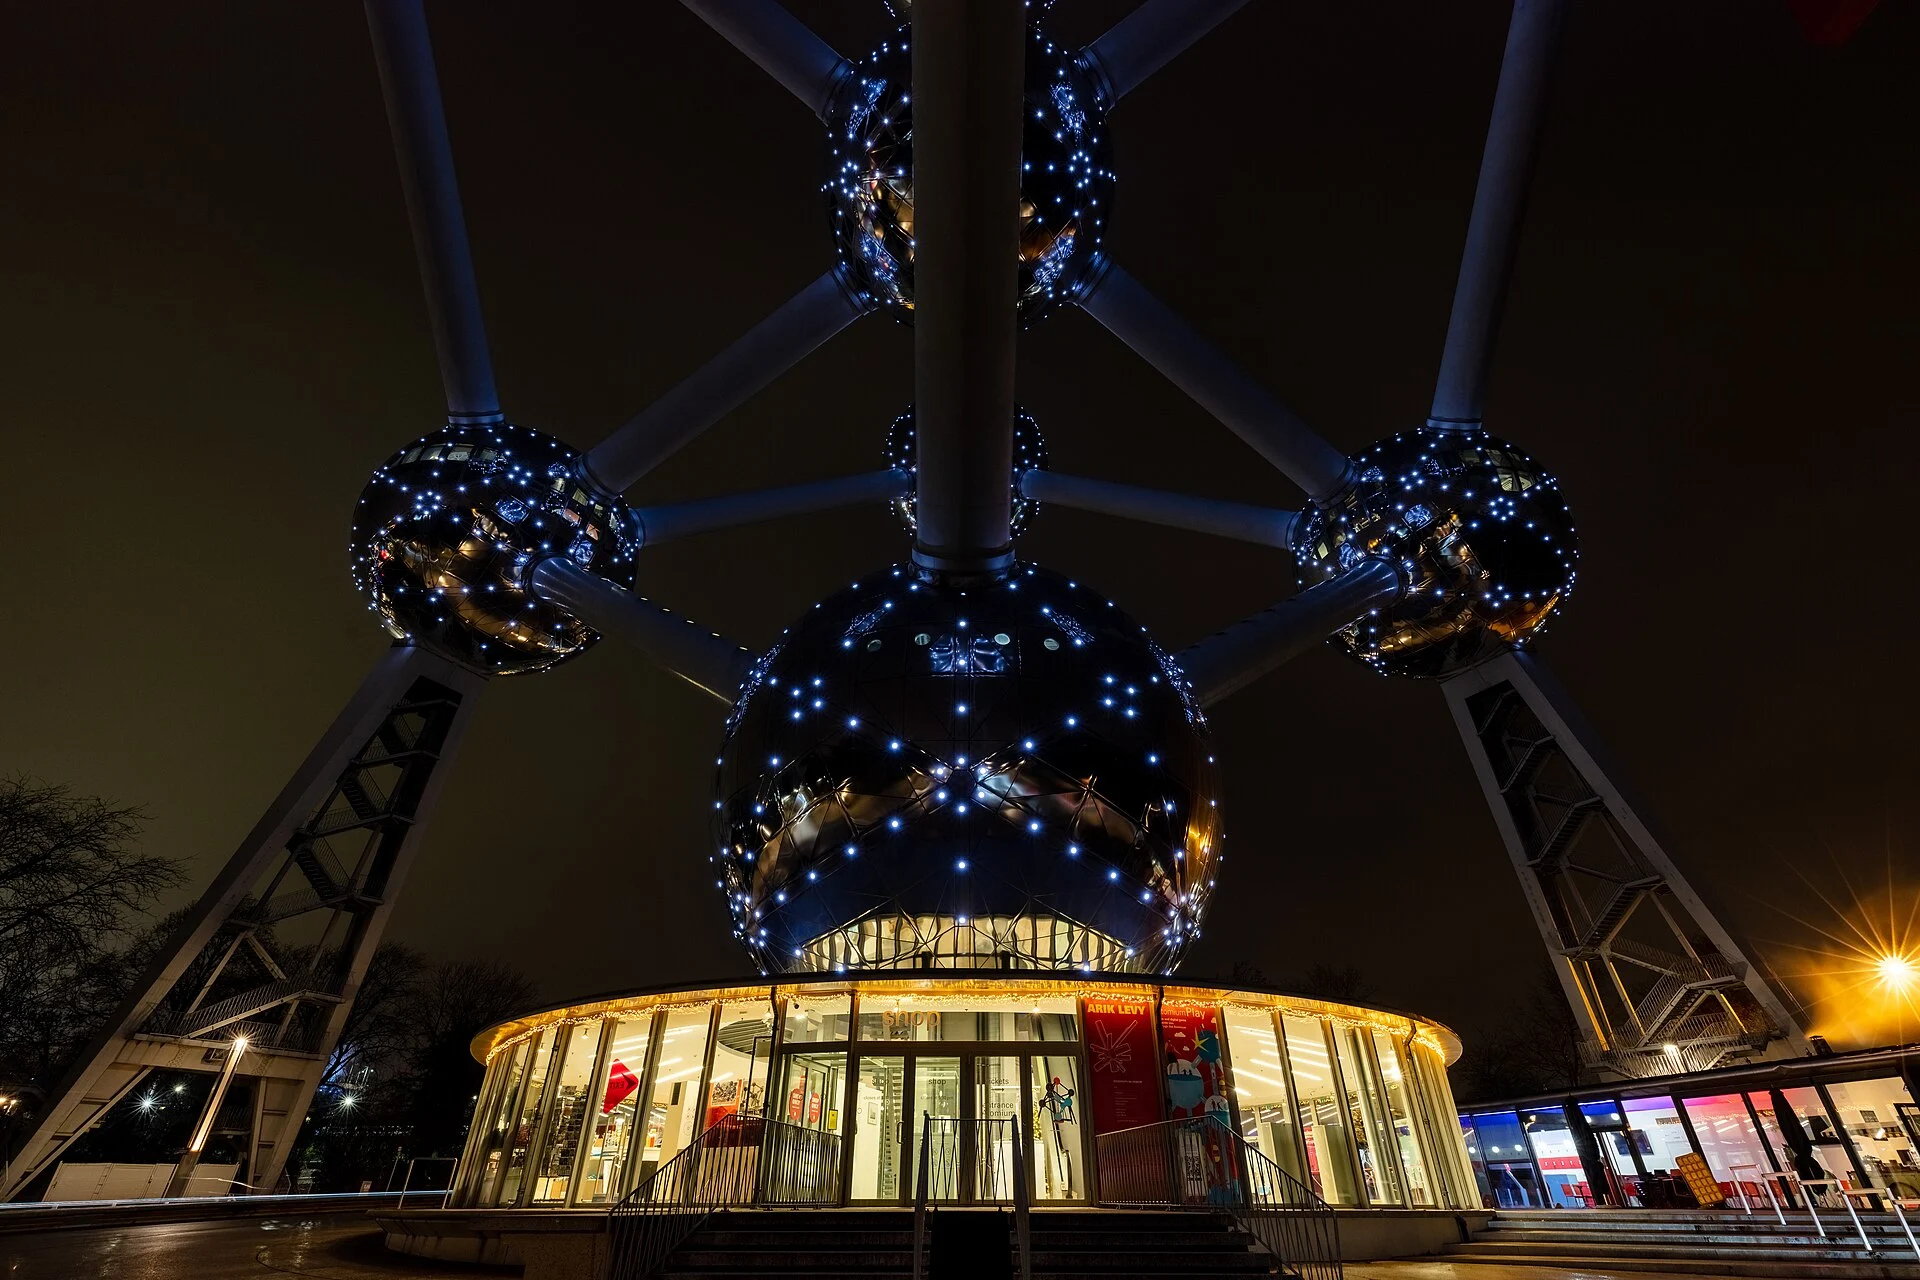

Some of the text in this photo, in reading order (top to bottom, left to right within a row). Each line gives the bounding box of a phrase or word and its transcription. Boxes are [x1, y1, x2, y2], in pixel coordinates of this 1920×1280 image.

[1087, 1003, 1146, 1015] ARIK LEVY
[882, 1007, 941, 1032] shop
[928, 1078, 947, 1086] shop
